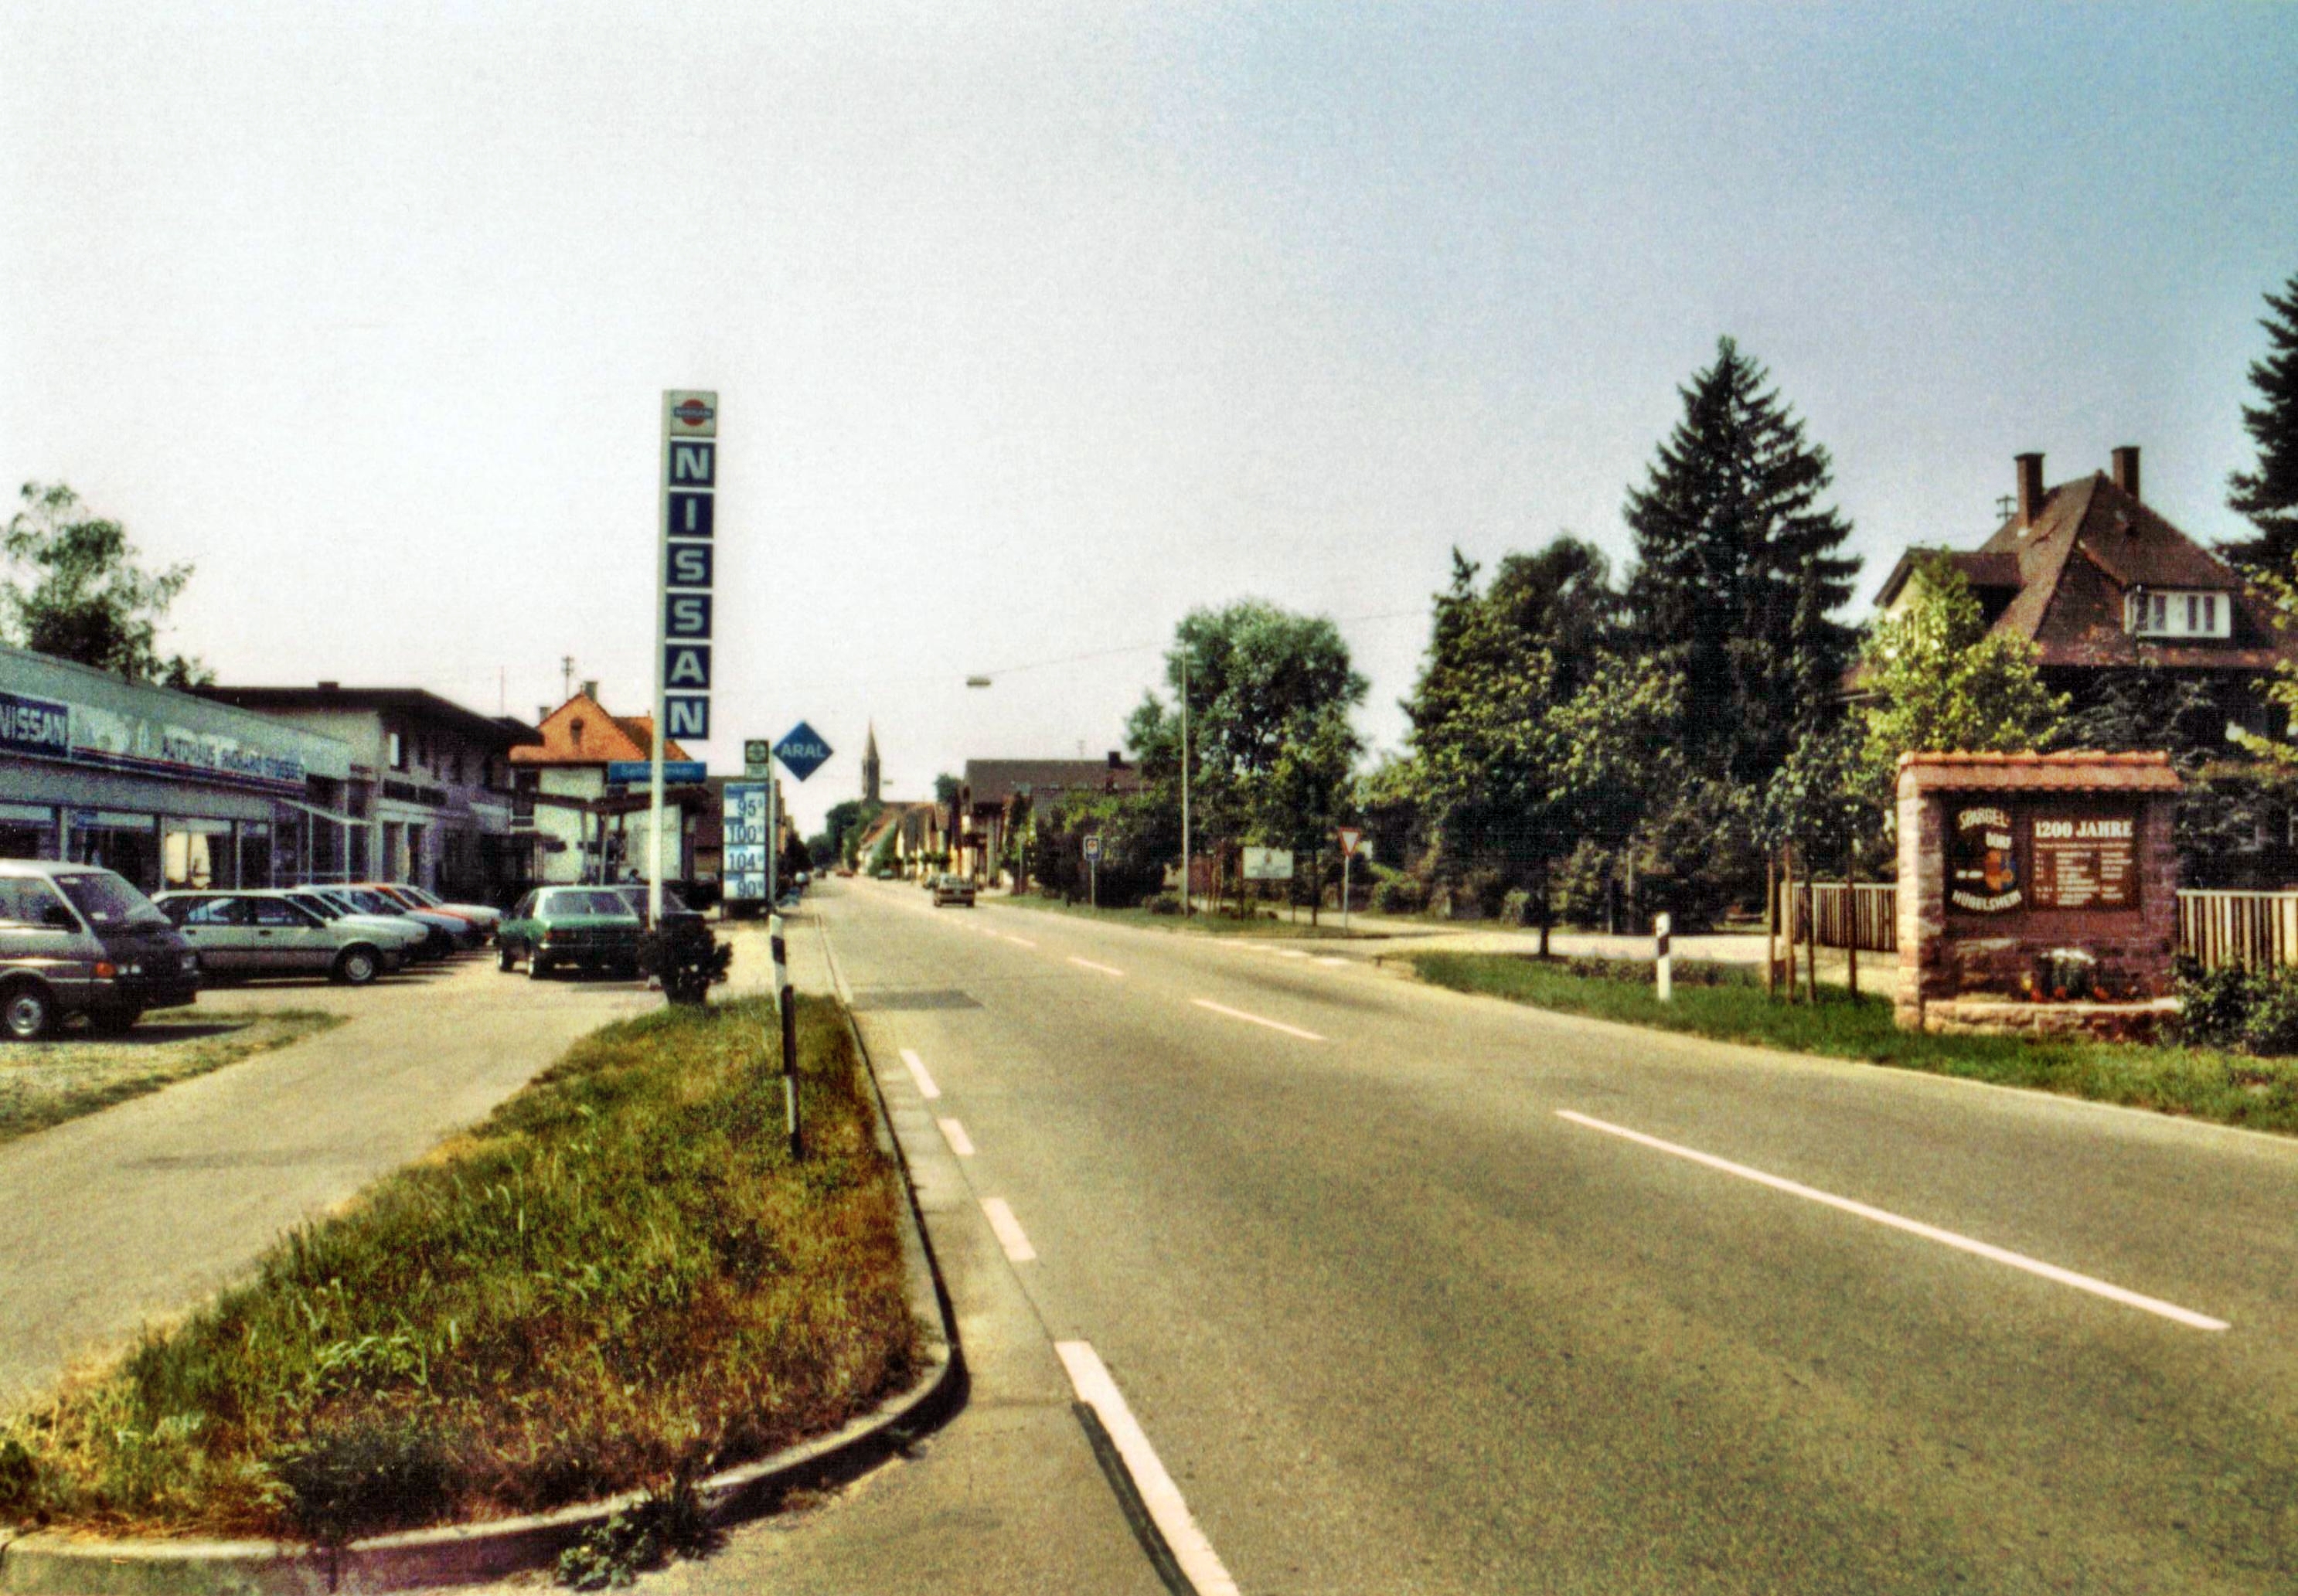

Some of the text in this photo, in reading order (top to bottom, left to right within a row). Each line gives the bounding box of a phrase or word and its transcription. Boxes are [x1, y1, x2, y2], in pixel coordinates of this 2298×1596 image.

[669, 447, 710, 733] NISSAN
[780, 743, 825, 759] ARAL
[2035, 820, 2133, 839] 1200 JAHRE
